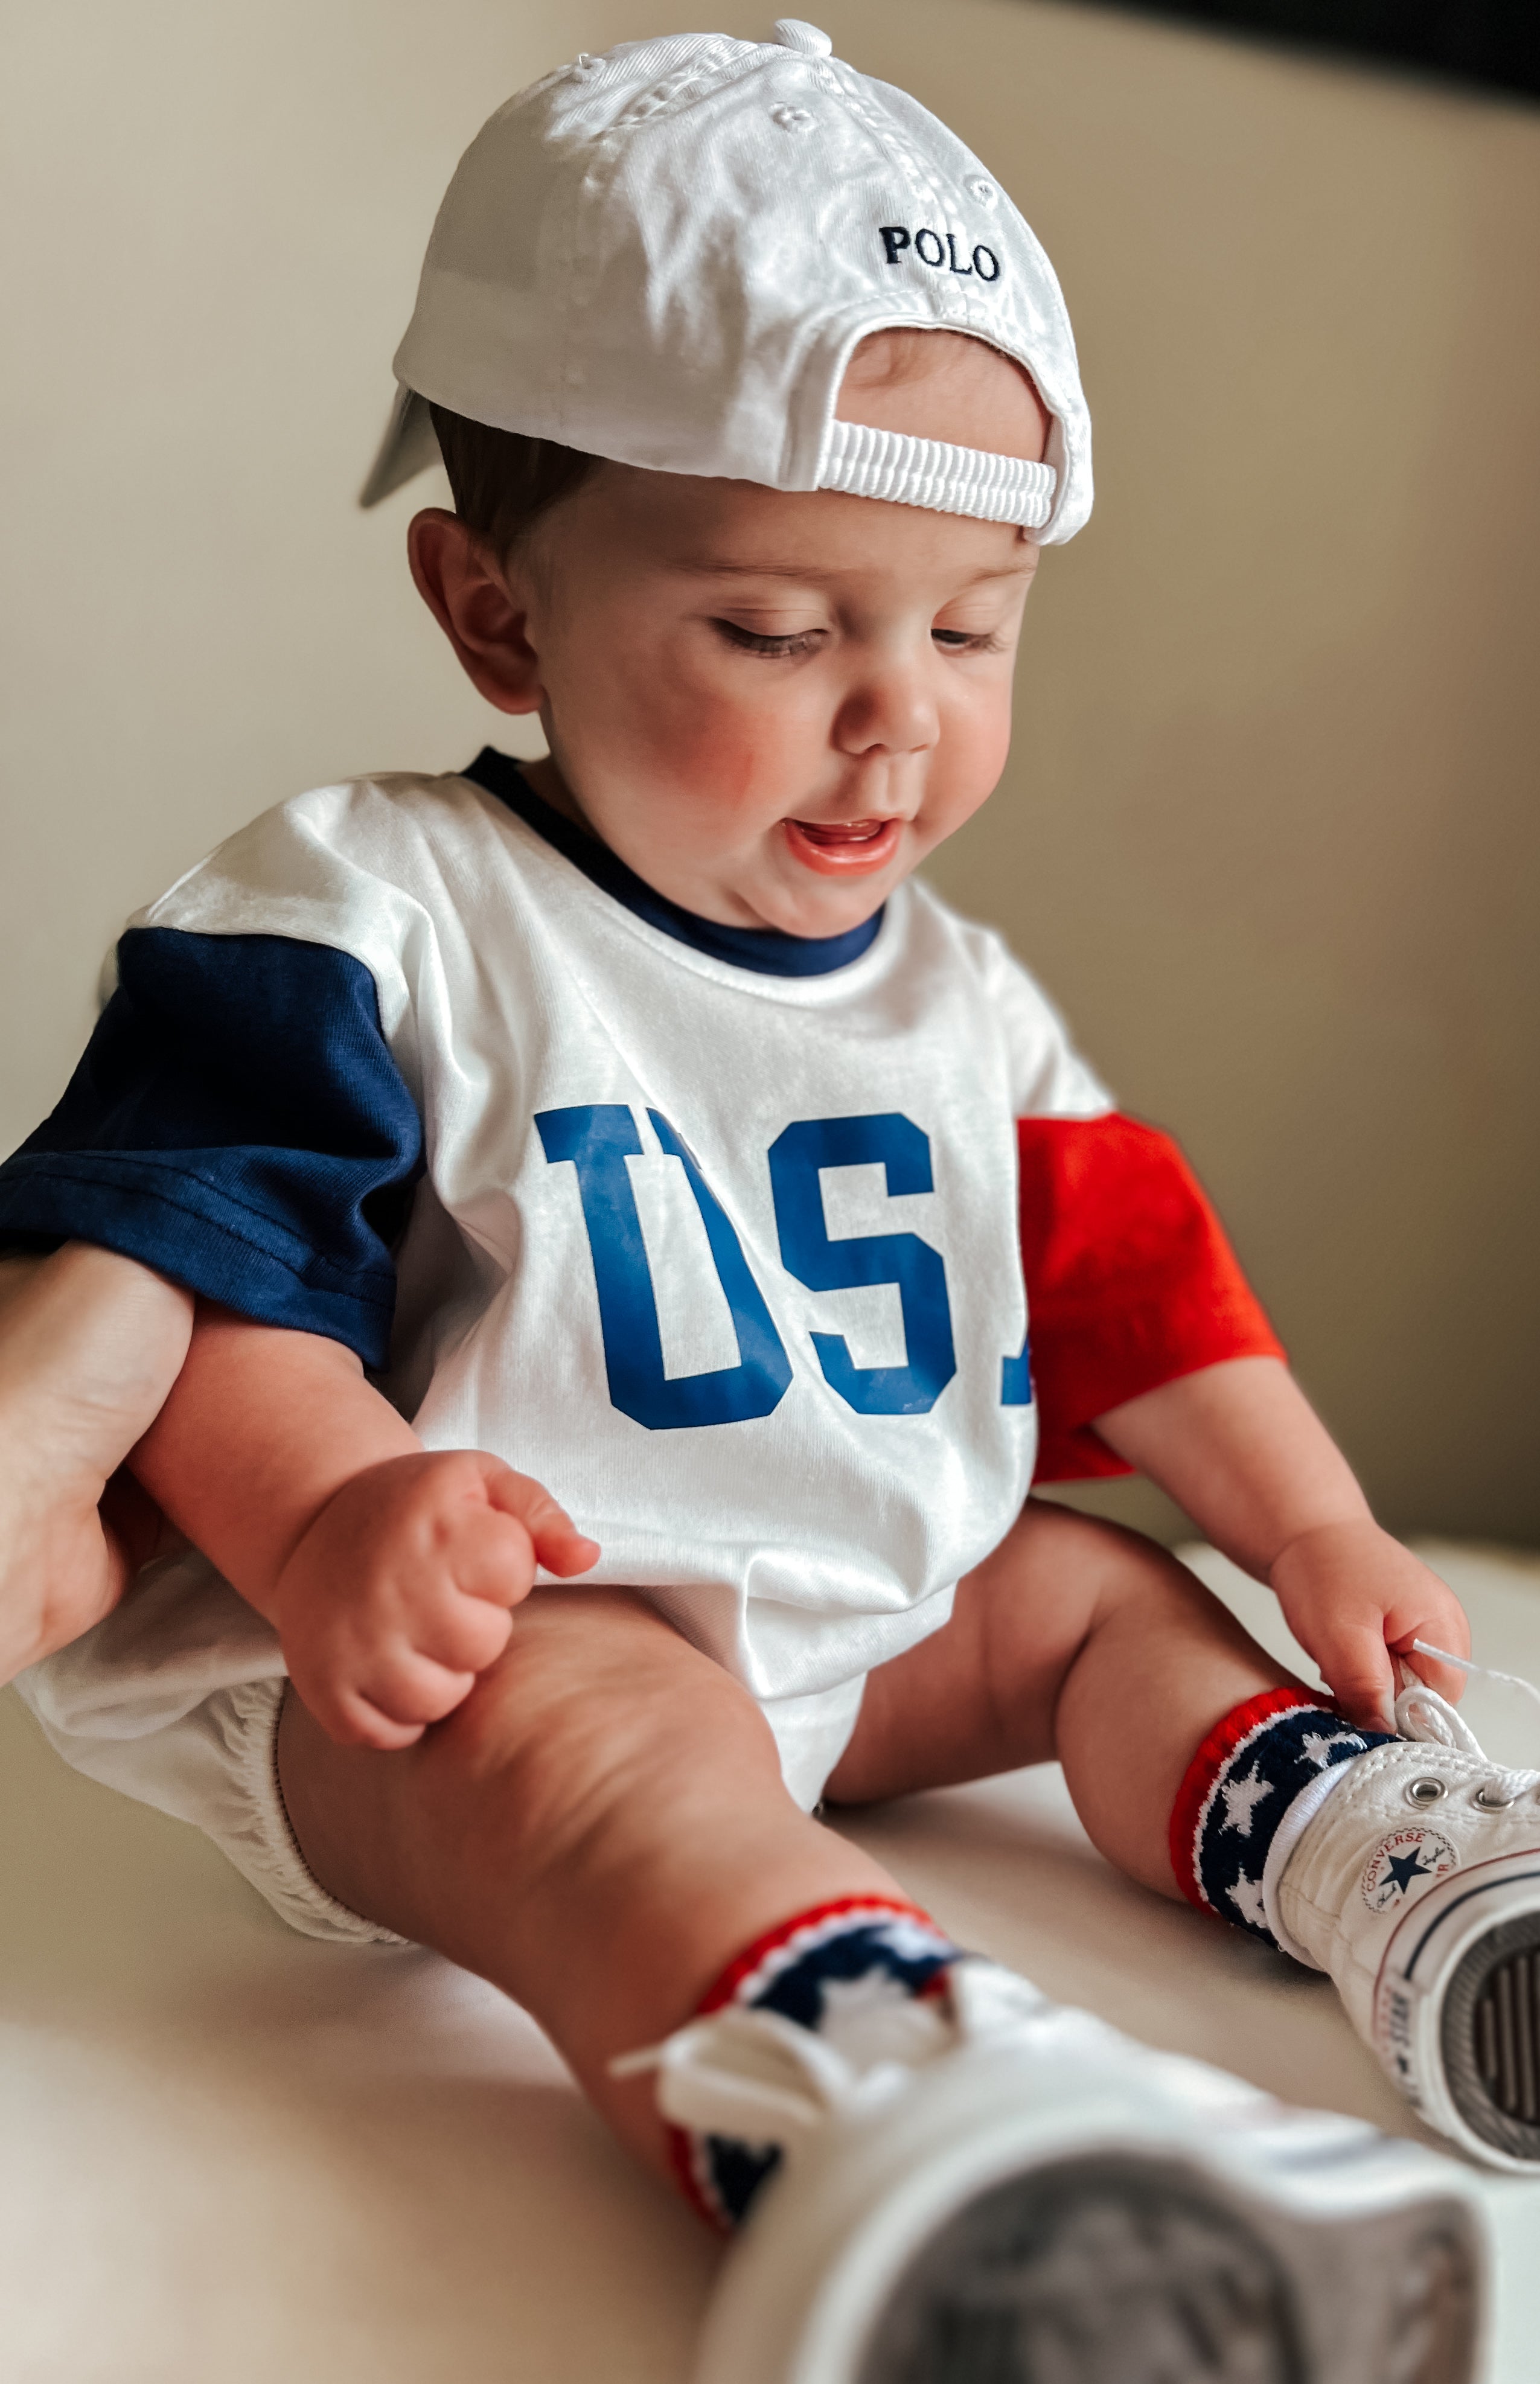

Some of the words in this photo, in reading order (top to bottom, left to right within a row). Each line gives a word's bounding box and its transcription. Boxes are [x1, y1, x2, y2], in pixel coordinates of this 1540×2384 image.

[879, 226, 1000, 281] POLO
[534, 1104, 1032, 1430] US
[1366, 1833, 1425, 1891] CONVERSE
